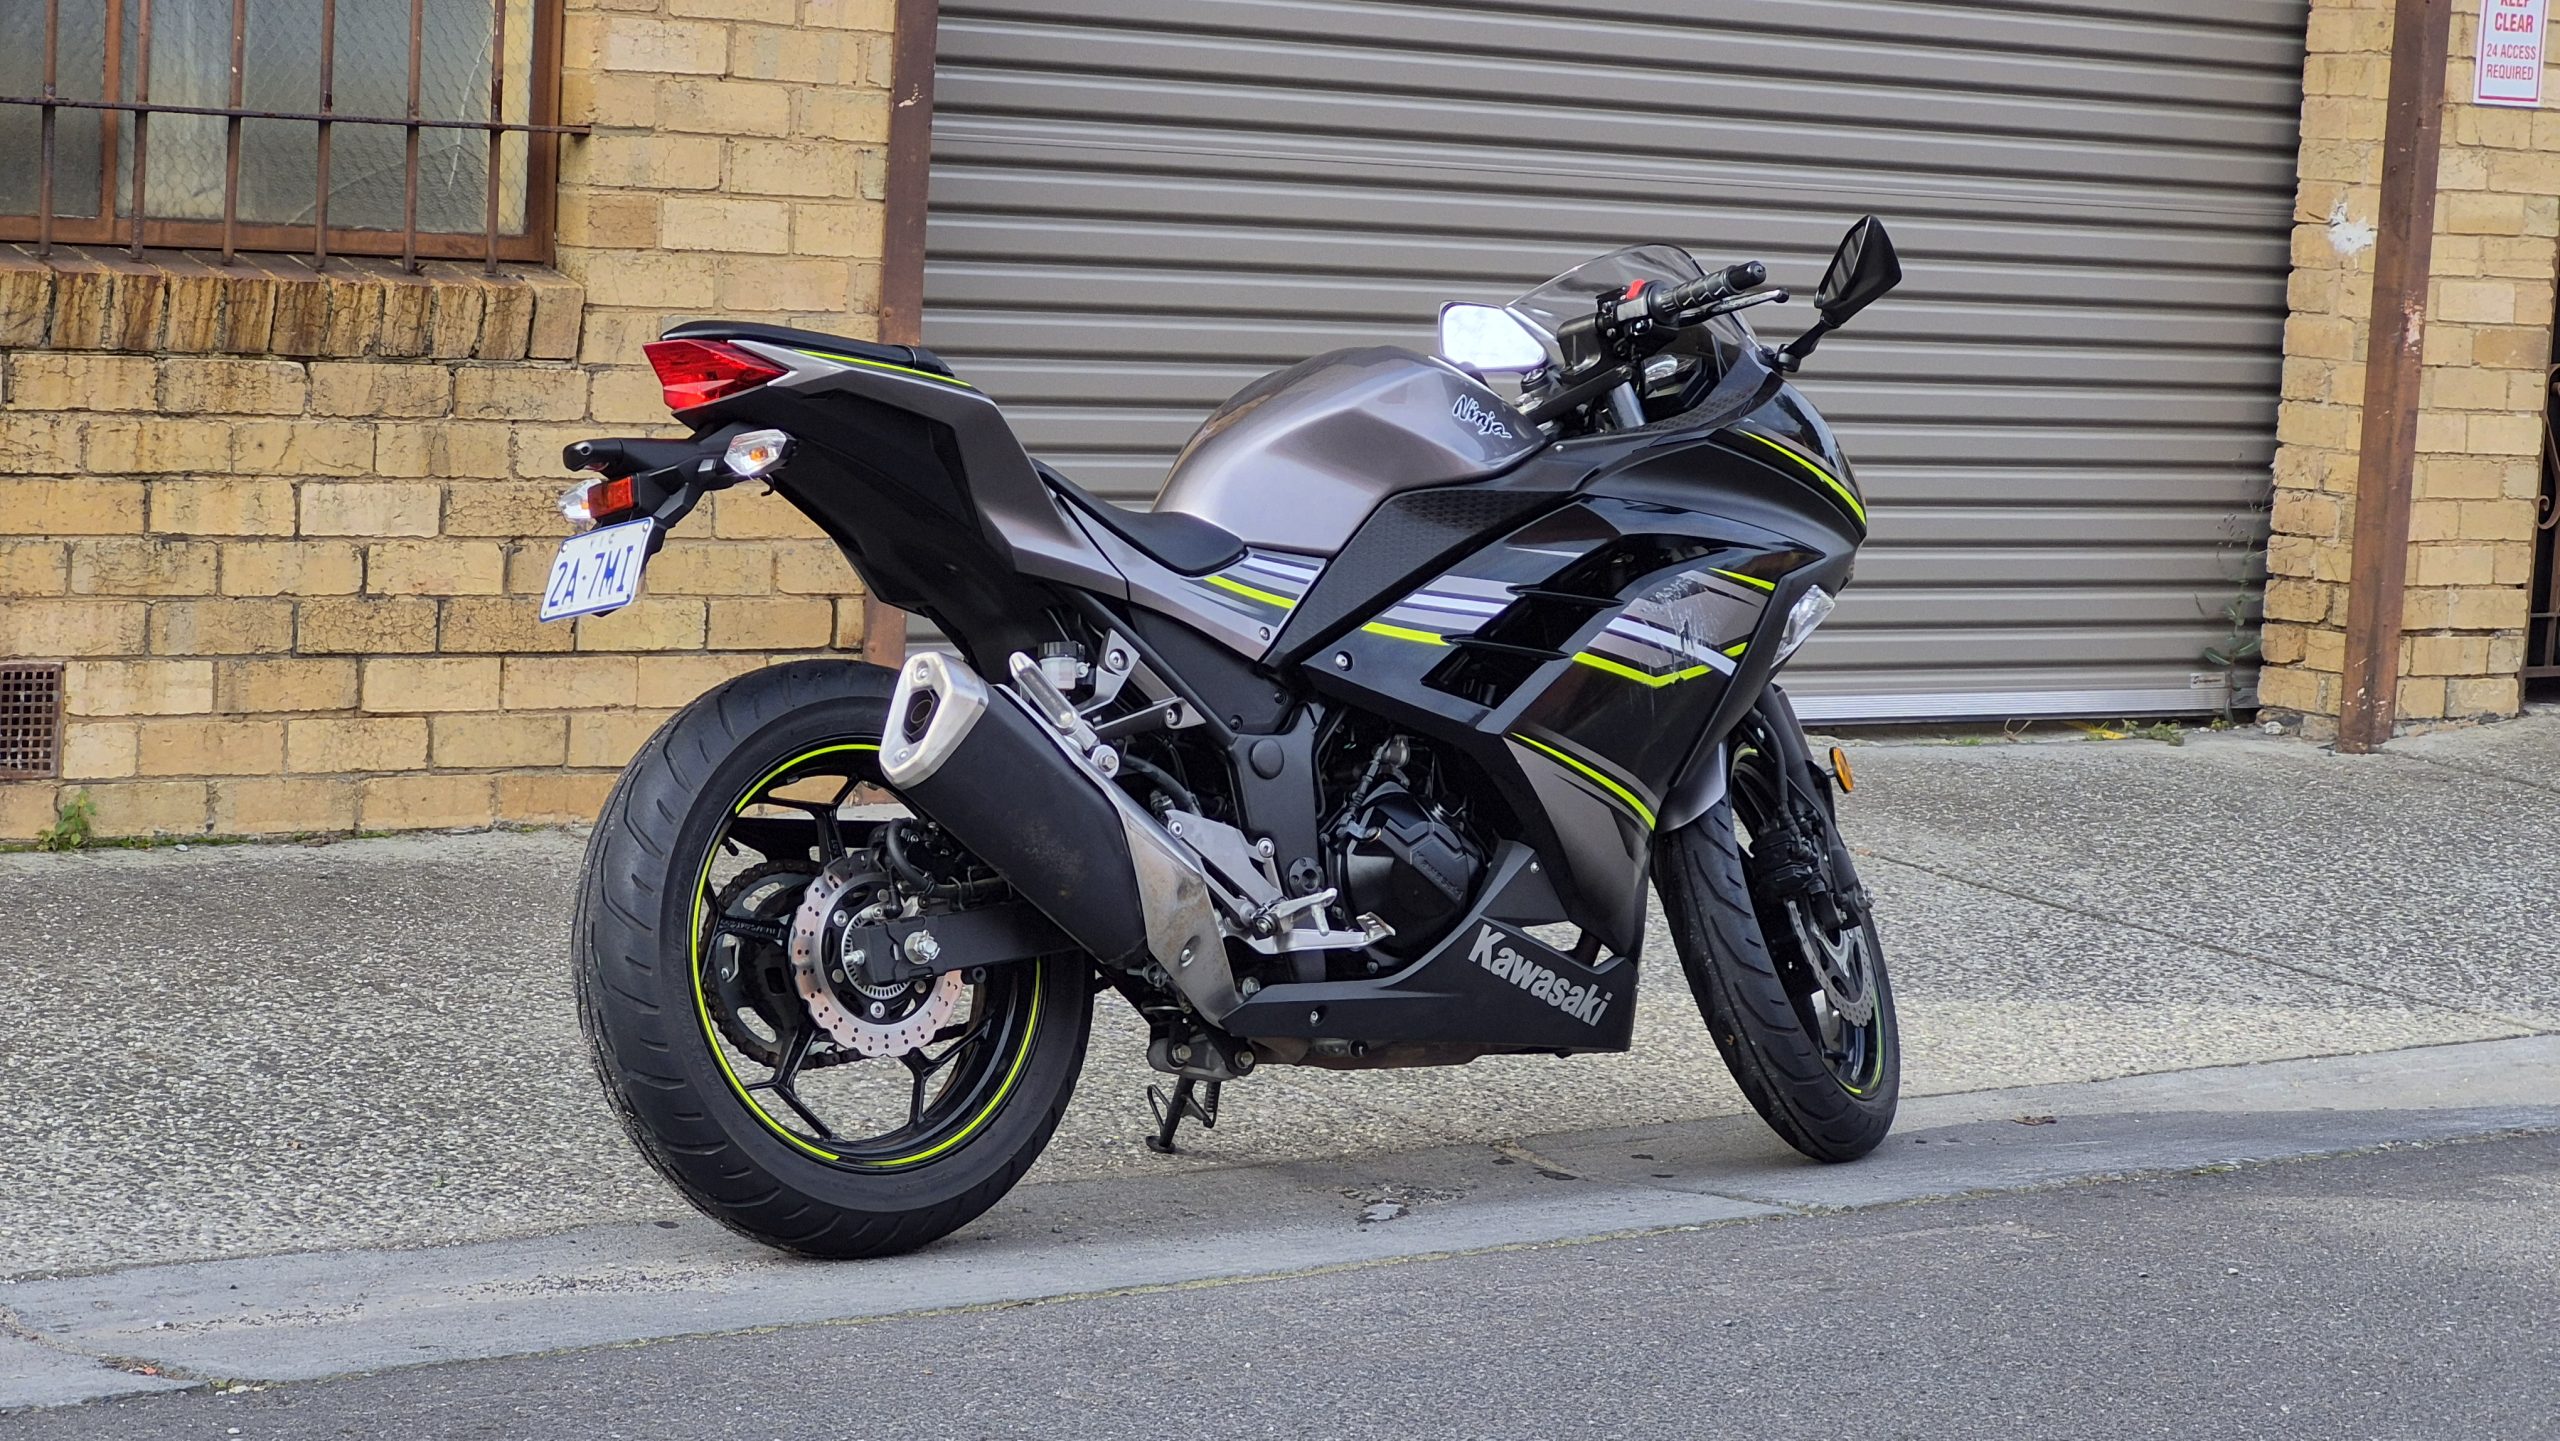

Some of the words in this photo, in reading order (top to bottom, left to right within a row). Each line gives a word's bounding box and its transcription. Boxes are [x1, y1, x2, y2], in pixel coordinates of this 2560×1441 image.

[2494, 12, 2534, 33] CLEAR
[2486, 43, 2498, 57] 24
[2500, 44, 2537, 60] ACCESS
[2486, 63, 2534, 80] REQUIRED
[1452, 393, 1512, 439] Ninja
[1467, 923, 1613, 1027] Kawasaki
